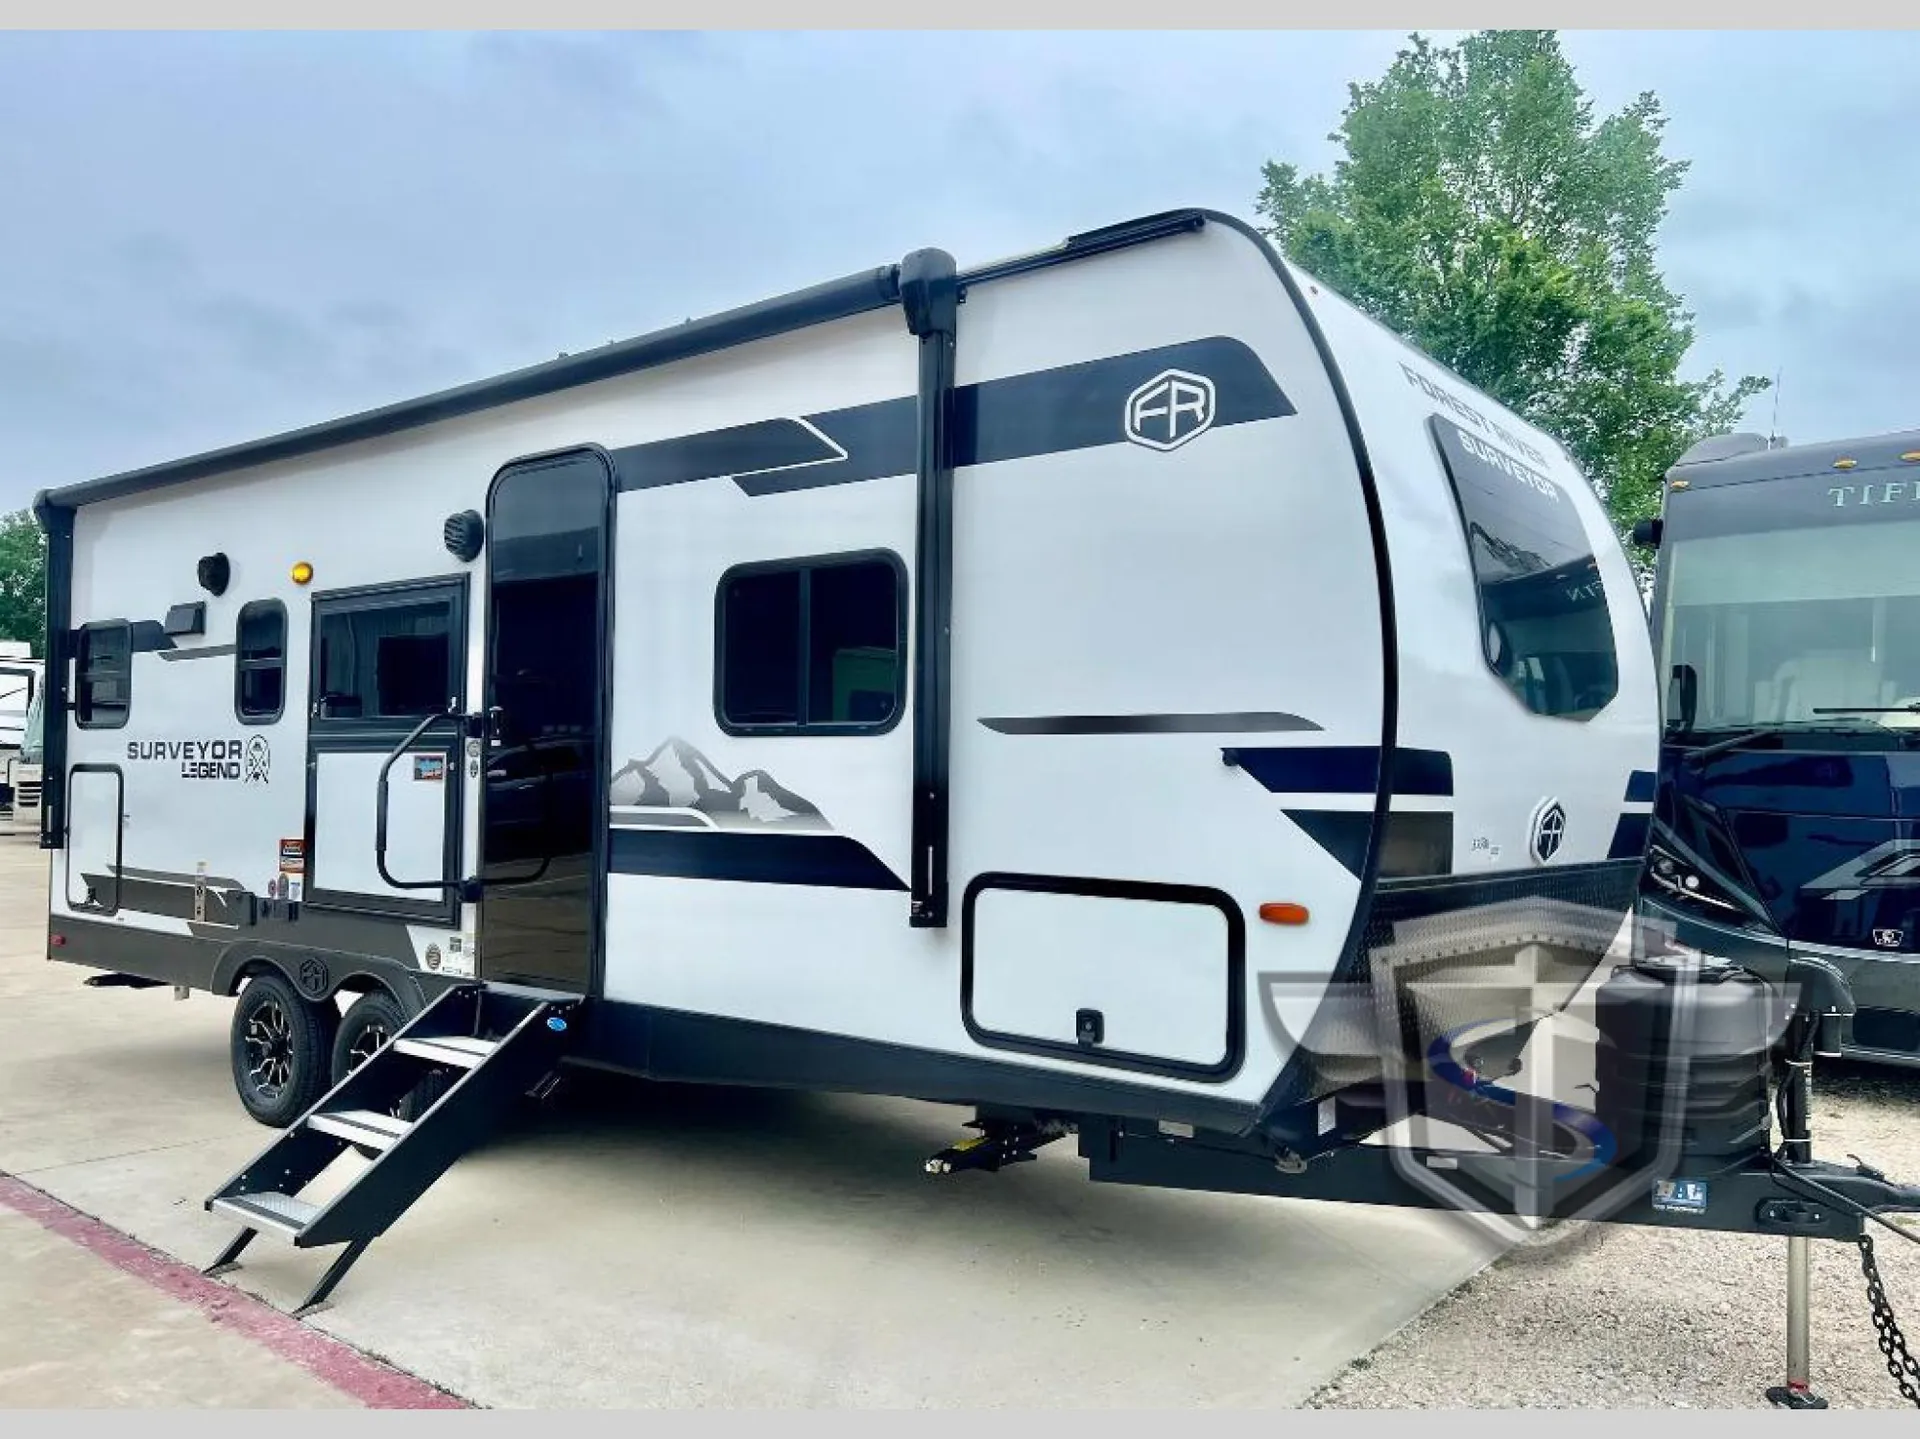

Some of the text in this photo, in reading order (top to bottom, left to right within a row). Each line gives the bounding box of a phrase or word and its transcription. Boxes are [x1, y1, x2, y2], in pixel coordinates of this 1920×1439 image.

[1397, 361, 1491, 433] FOREST
[1457, 428, 1560, 503] SURVEYOR
[127, 740, 242, 760] SURVEYOR
[181, 762, 241, 779] LEGEND
